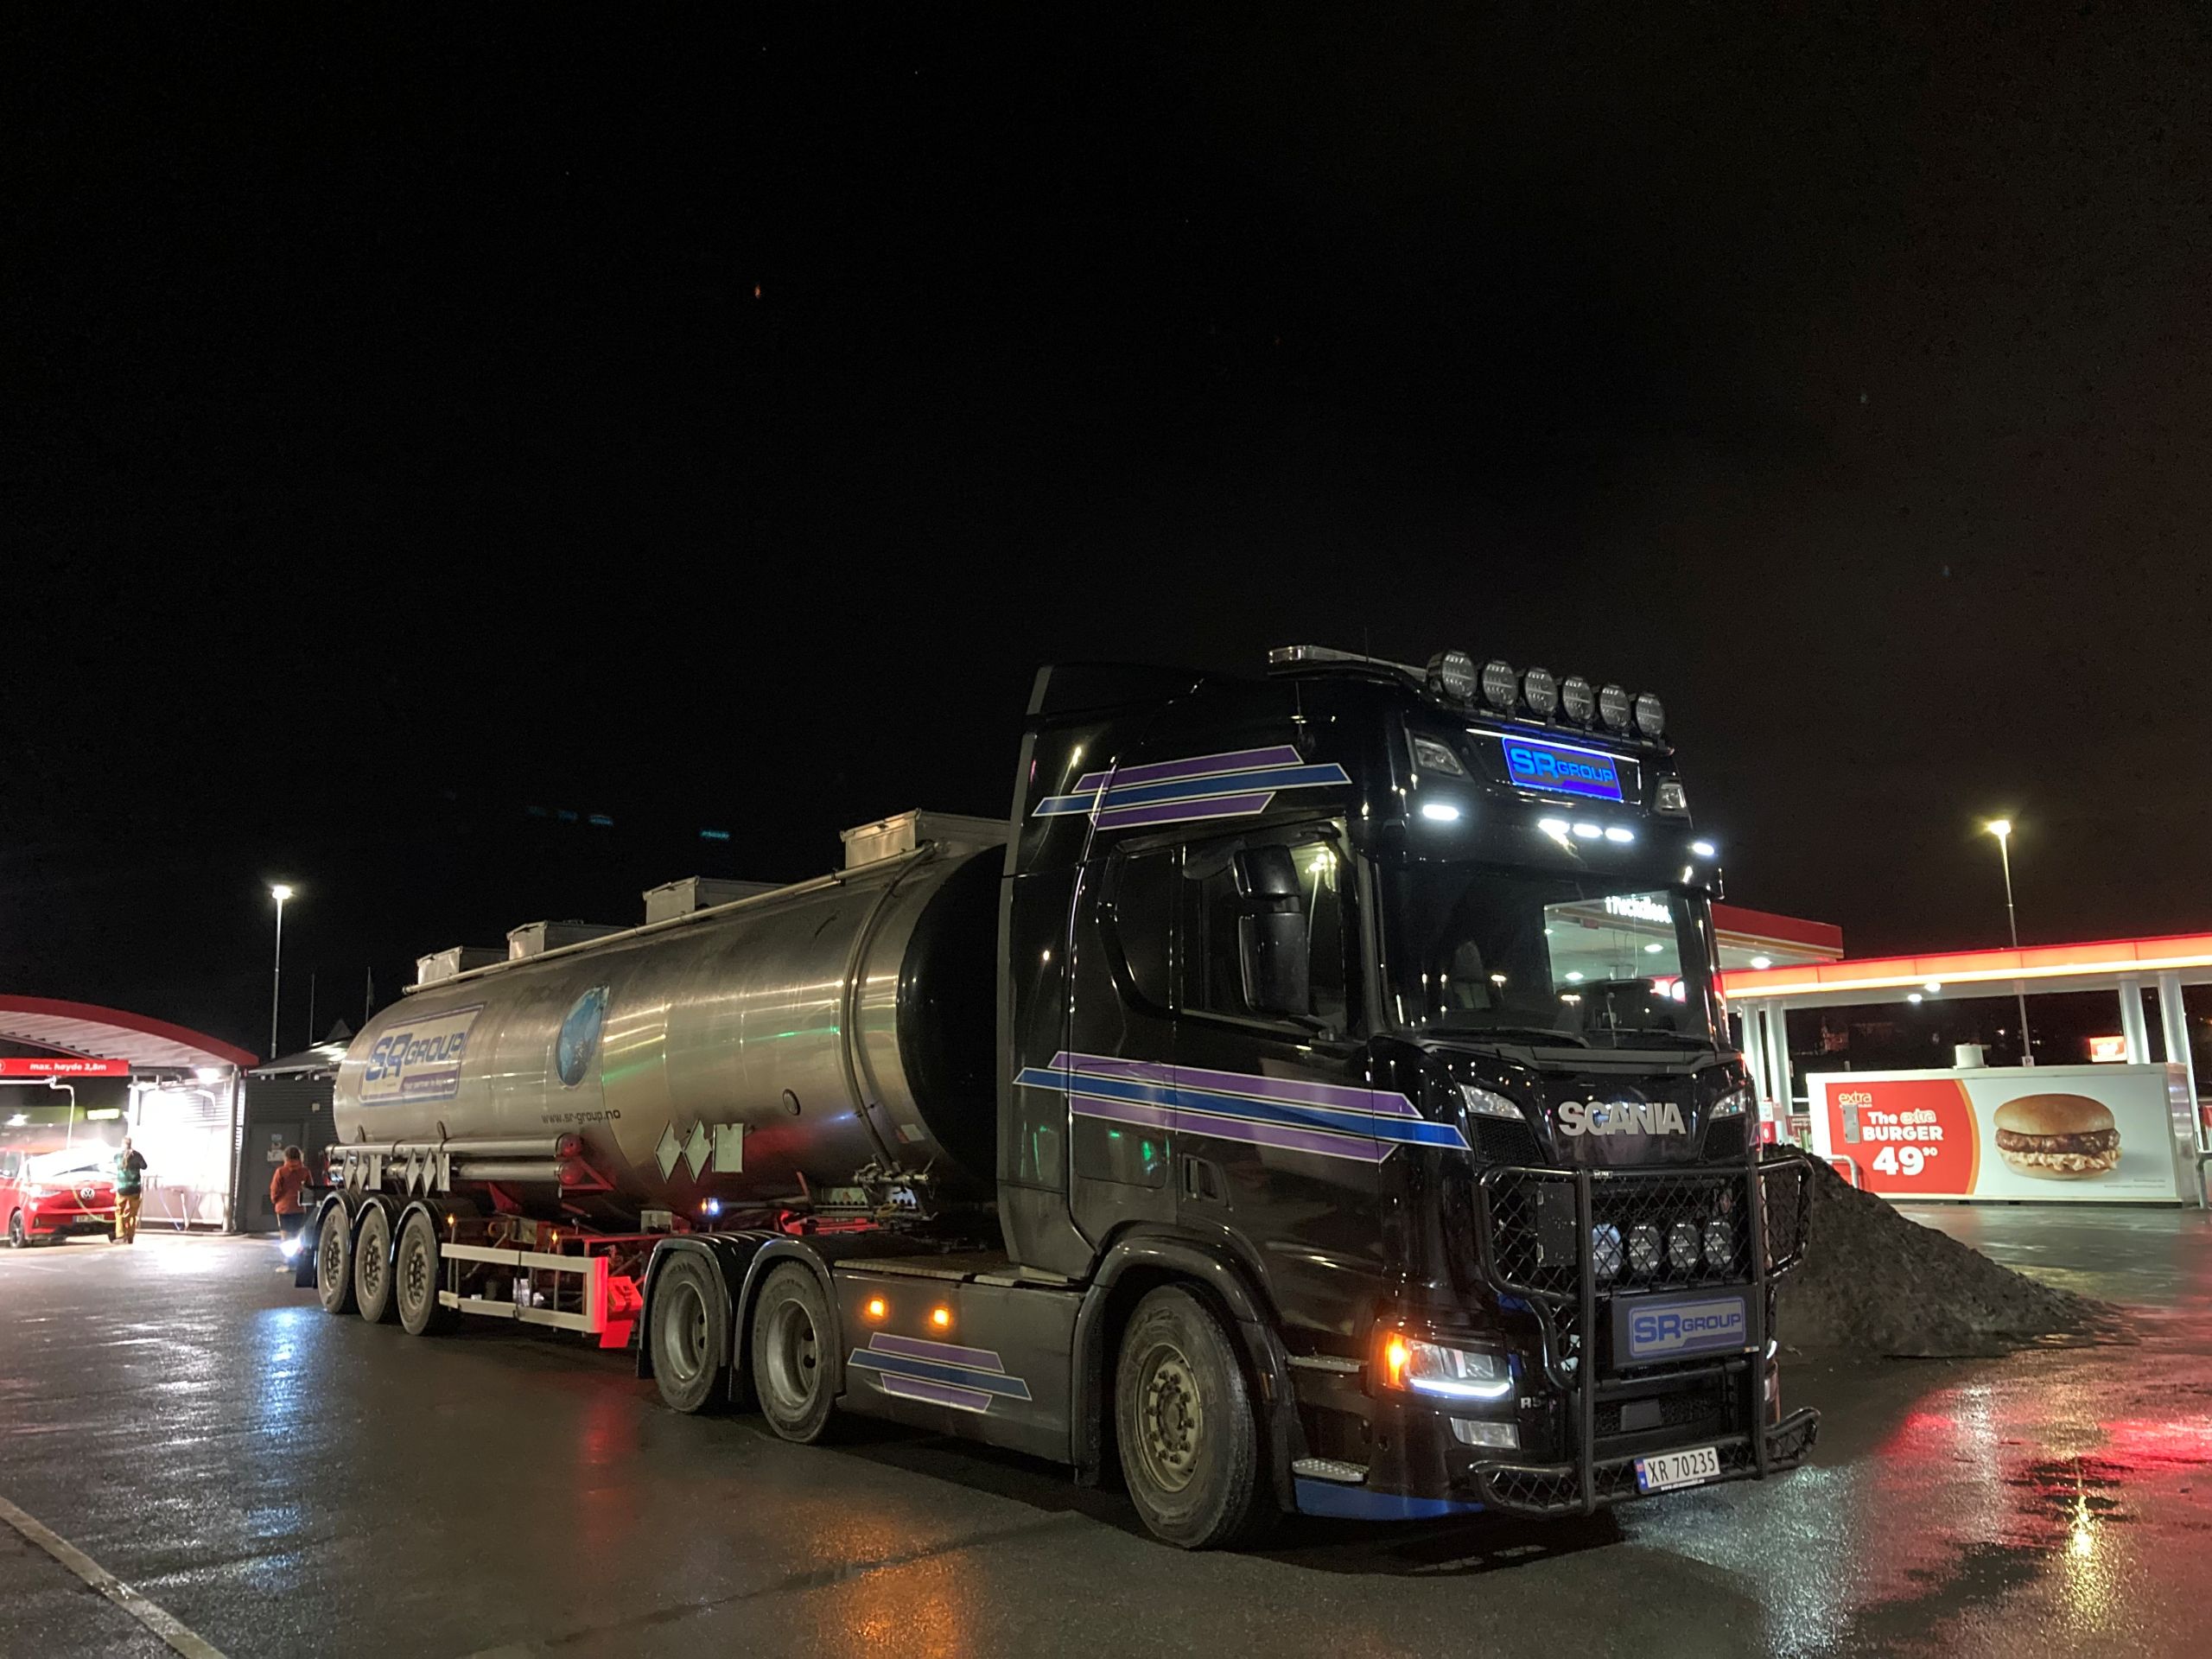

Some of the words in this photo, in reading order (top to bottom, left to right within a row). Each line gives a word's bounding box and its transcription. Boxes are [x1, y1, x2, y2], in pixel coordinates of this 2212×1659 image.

[1510, 747, 1559, 779] SR
[1556, 761, 1614, 782] GROUP
[54, 1063, 82, 1071] høyde
[365, 1033, 413, 1081] SR
[404, 1032, 466, 1066] GROUP
[1838, 1090, 1872, 1104] extra
[541, 1109, 621, 1124] www.sr-group.no
[1558, 1101, 1687, 1136] SCANIA
[1867, 1111, 1898, 1124] The
[1899, 1108, 1937, 1125] extra
[1862, 1126, 1944, 1141] BURGER
[1872, 1146, 1925, 1176] 49
[1634, 1313, 1681, 1344] SR
[1681, 1313, 1742, 1332] GROUP
[1648, 1459, 1669, 1484] XR
[1672, 1451, 1716, 1478] 70235
